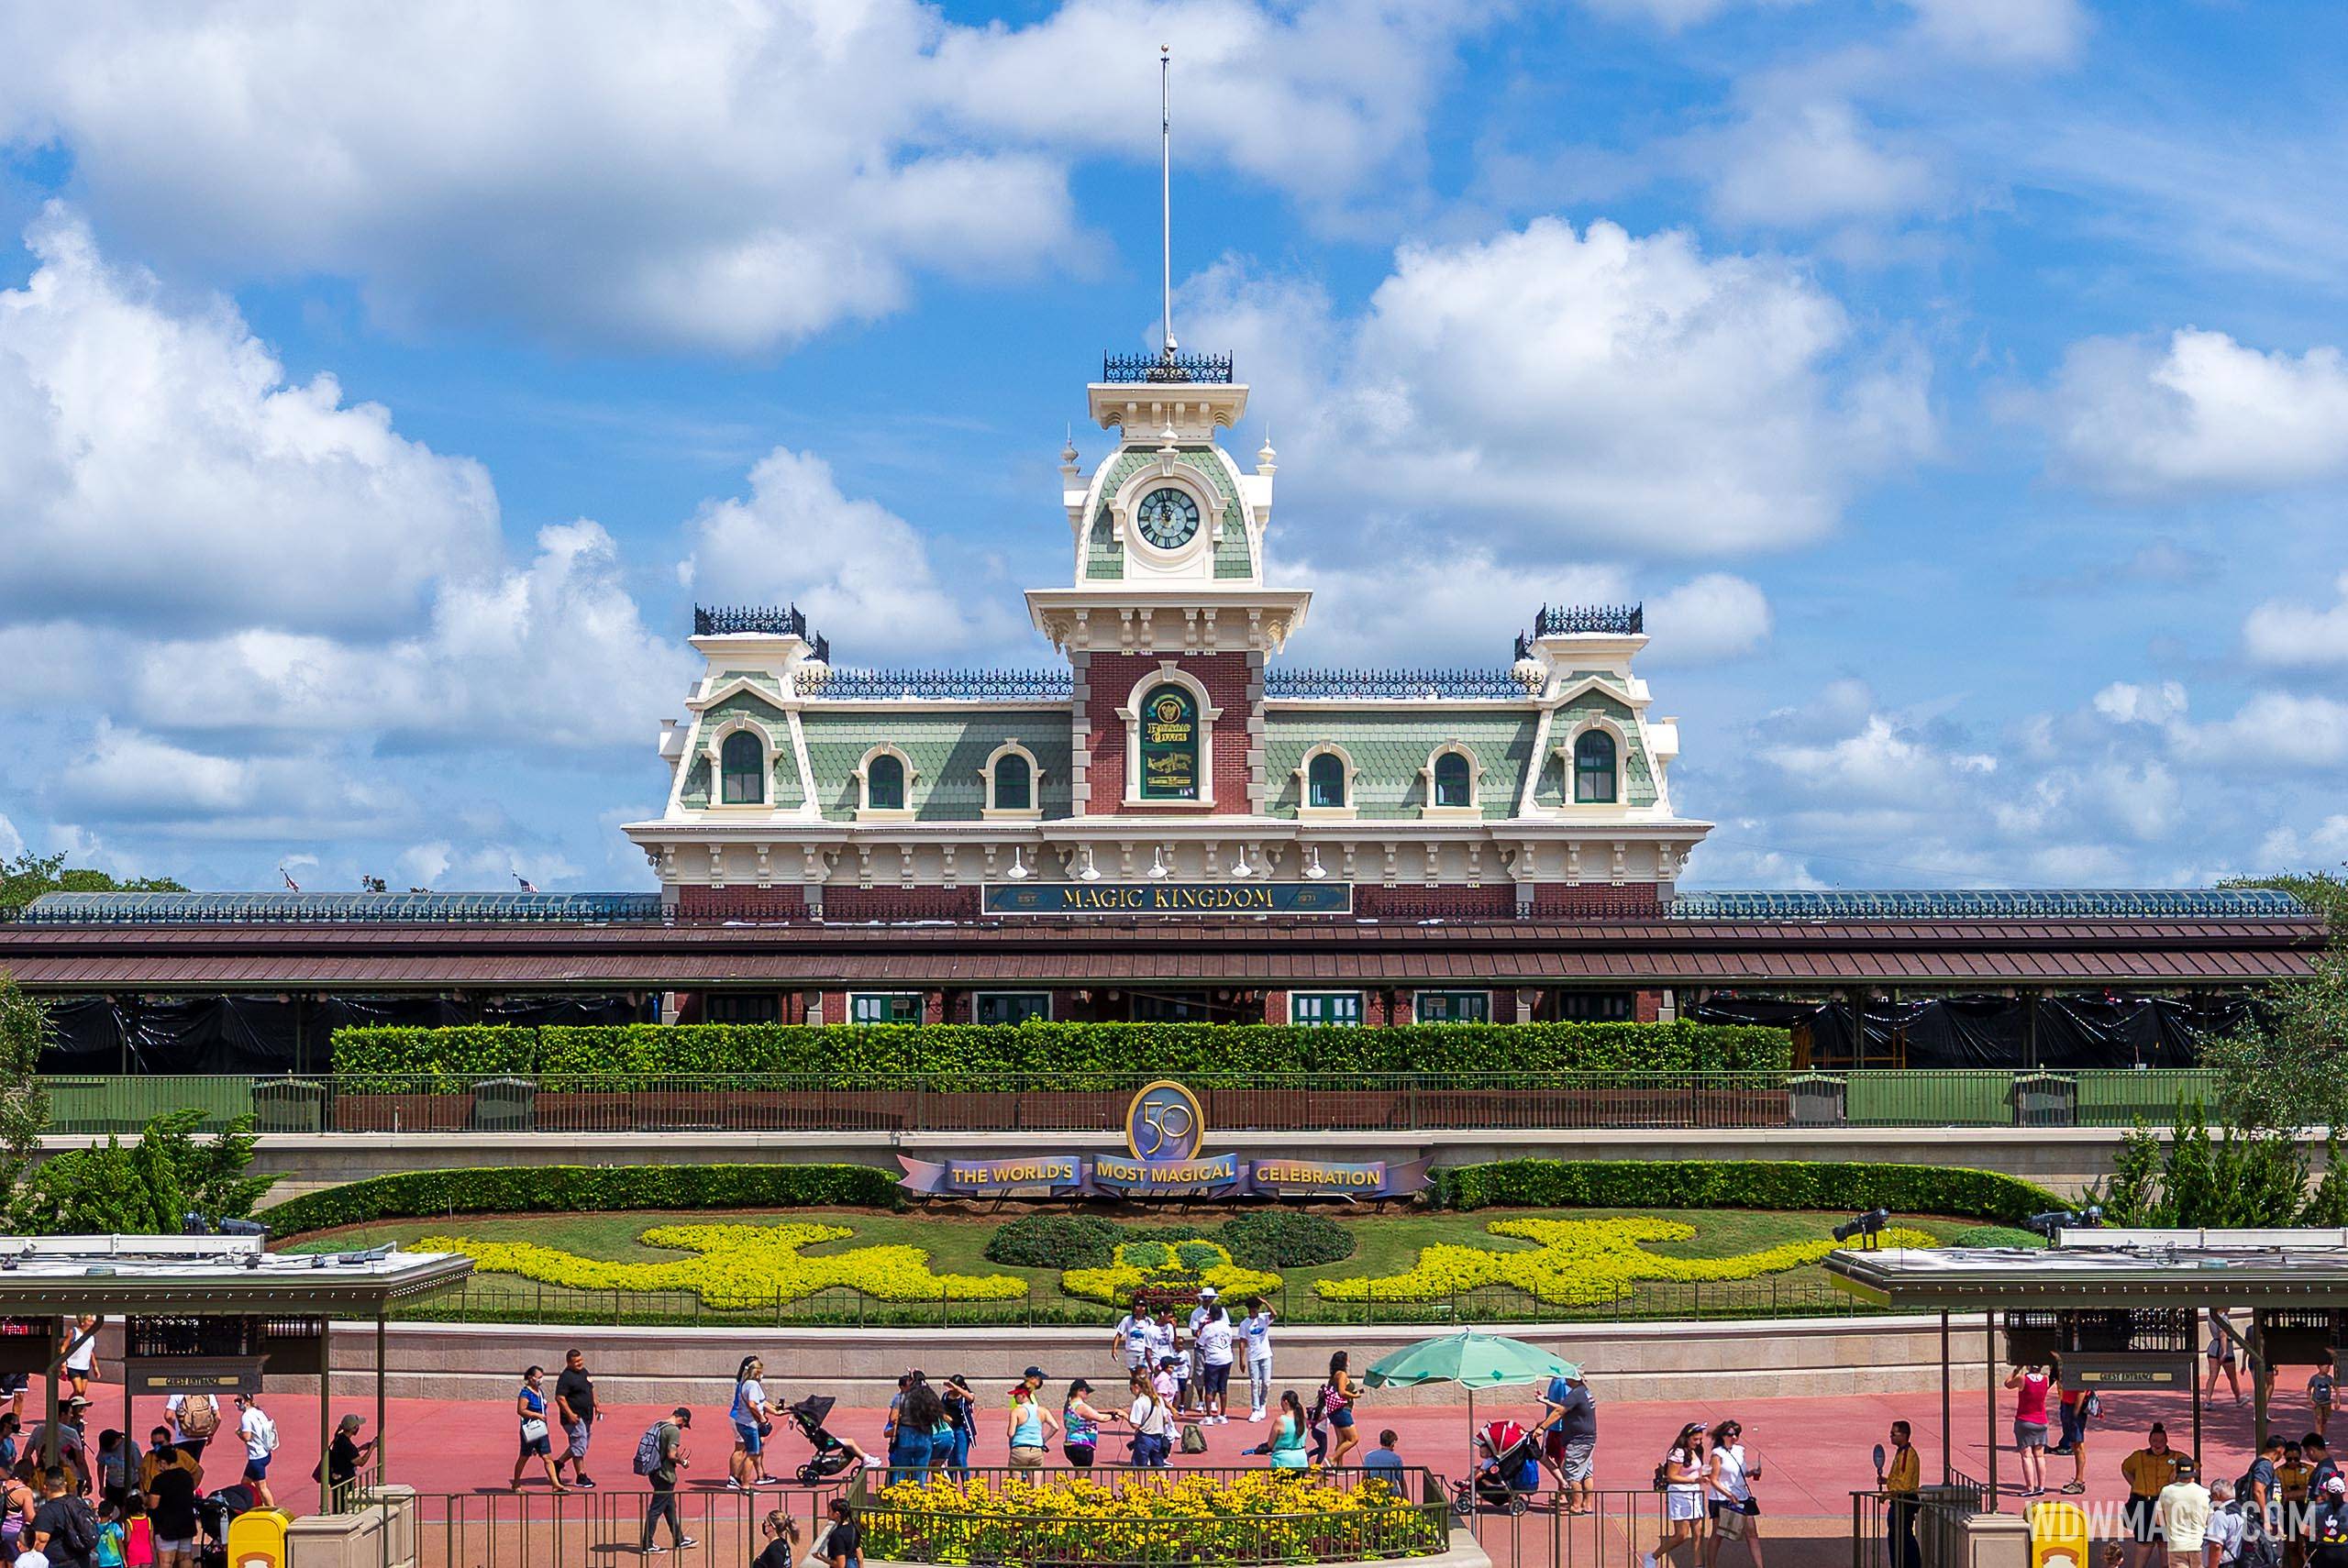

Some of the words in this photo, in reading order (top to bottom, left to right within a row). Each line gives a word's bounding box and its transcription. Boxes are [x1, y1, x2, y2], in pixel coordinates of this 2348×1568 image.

[1062, 889, 1143, 908] MAGIC
[1155, 889, 1274, 908] KINGDOM
[1144, 1101, 1192, 1154] 50
[952, 1167, 989, 1184] THE
[992, 1164, 1073, 1183] WORLD'S
[1097, 1161, 1146, 1182] MOST
[1151, 1162, 1235, 1183] MAGICAL
[1257, 1166, 1380, 1186] CELEBRATION
